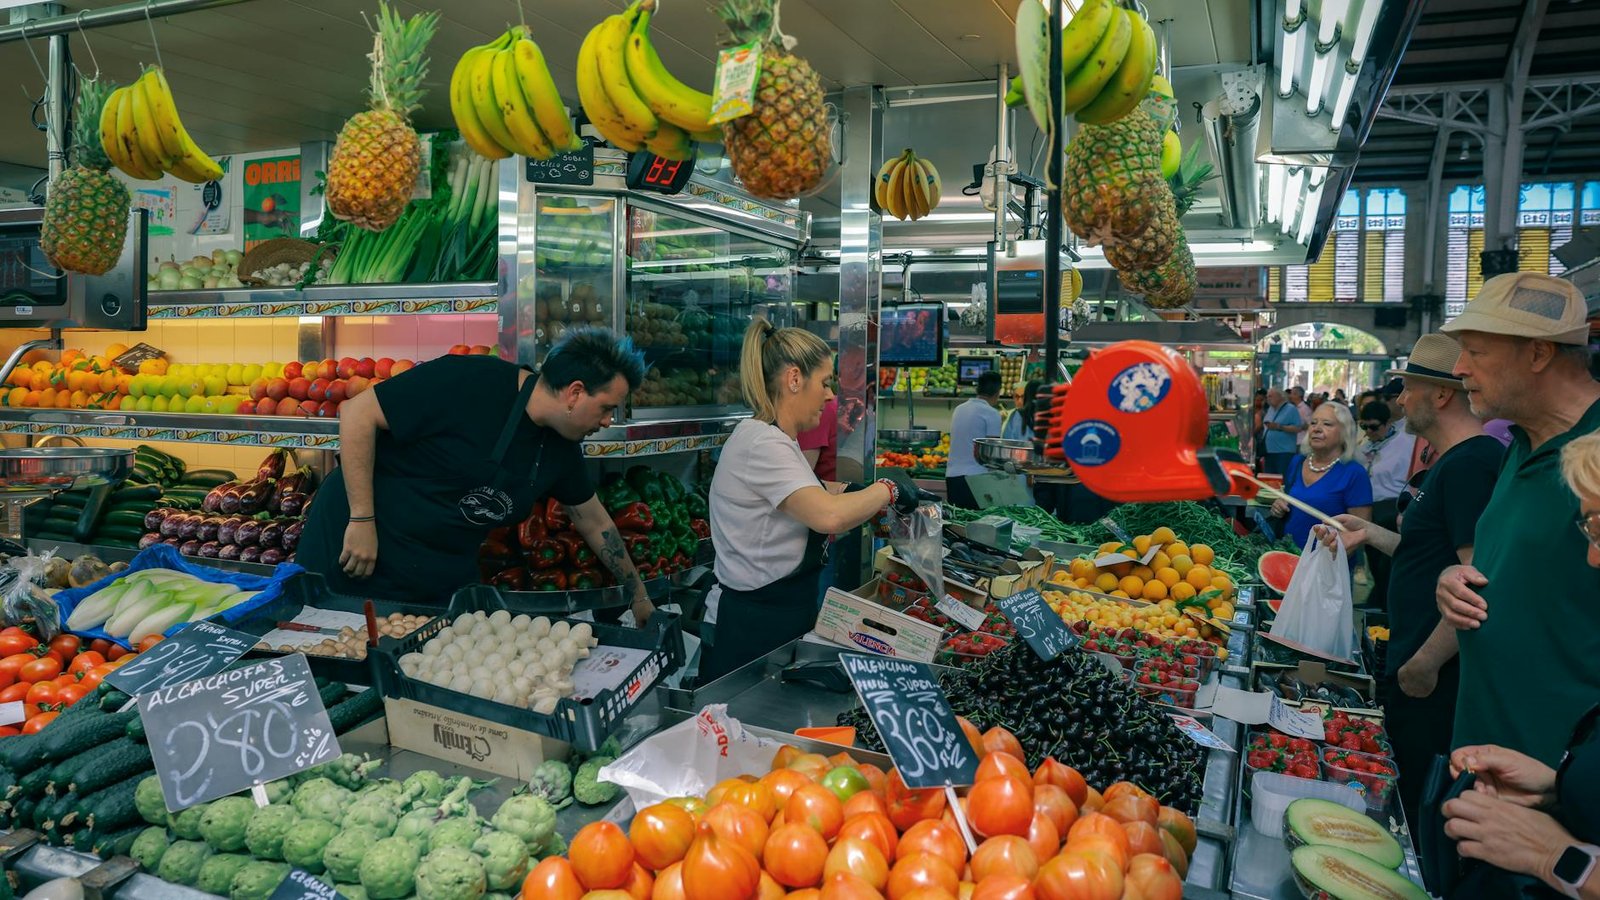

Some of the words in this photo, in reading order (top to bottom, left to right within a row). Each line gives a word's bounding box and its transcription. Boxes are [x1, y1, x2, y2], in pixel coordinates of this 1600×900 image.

[849, 657, 918, 675] VALENCIANO
[147, 660, 285, 711] ALCACHOFAS
[444, 716, 477, 732] Membrillo
[433, 723, 473, 755] Emily
